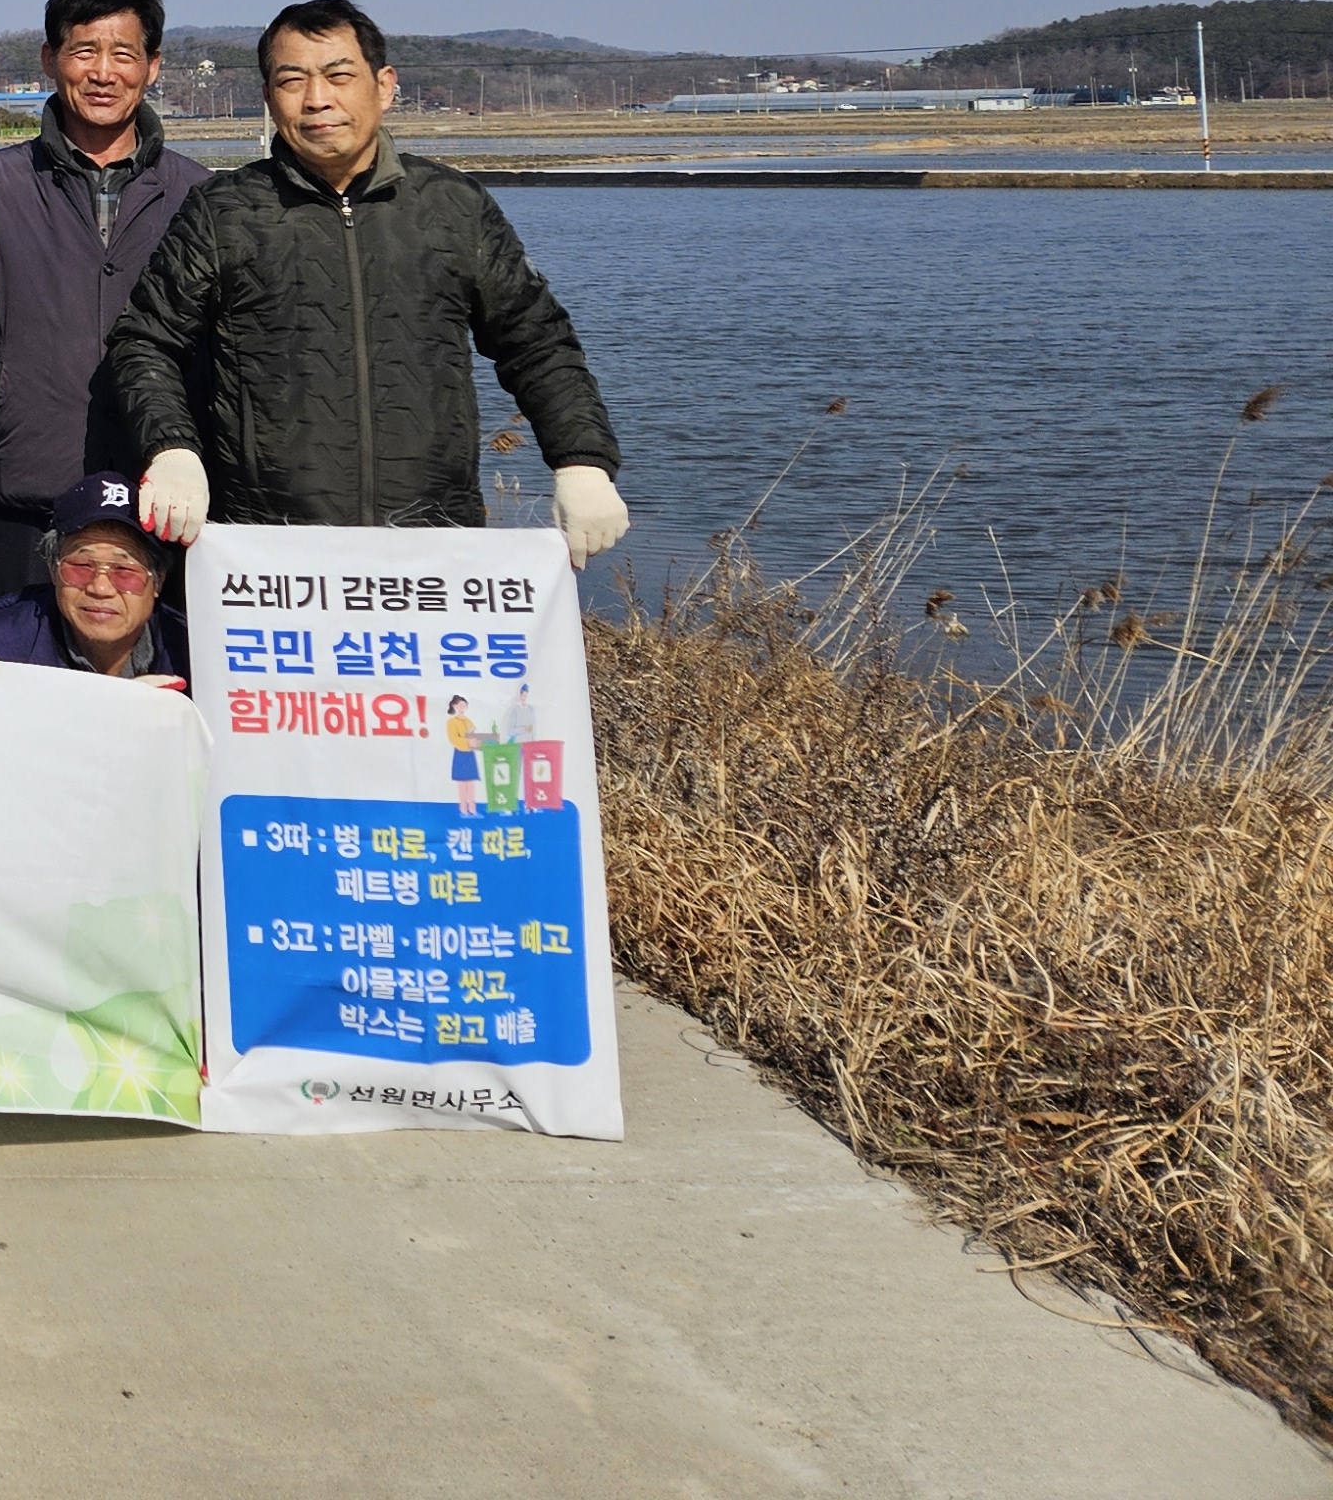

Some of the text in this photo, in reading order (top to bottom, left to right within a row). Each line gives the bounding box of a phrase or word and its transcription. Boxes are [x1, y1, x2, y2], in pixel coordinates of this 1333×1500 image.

[221, 573, 534, 613] 쓰레기 감량을 위한
[225, 628, 528, 679] 군민 실천 운동
[228, 689, 429, 737] 함께해요!
[333, 824, 361, 859] 병
[446, 827, 474, 861] 캔
[335, 867, 482, 906] 페트병 따로
[520, 919, 573, 955] 떼고
[340, 965, 451, 1004] 이물질은
[339, 1003, 537, 1046] 박스는 접고 배출
[348, 1085, 523, 1113] 선원면사무소
